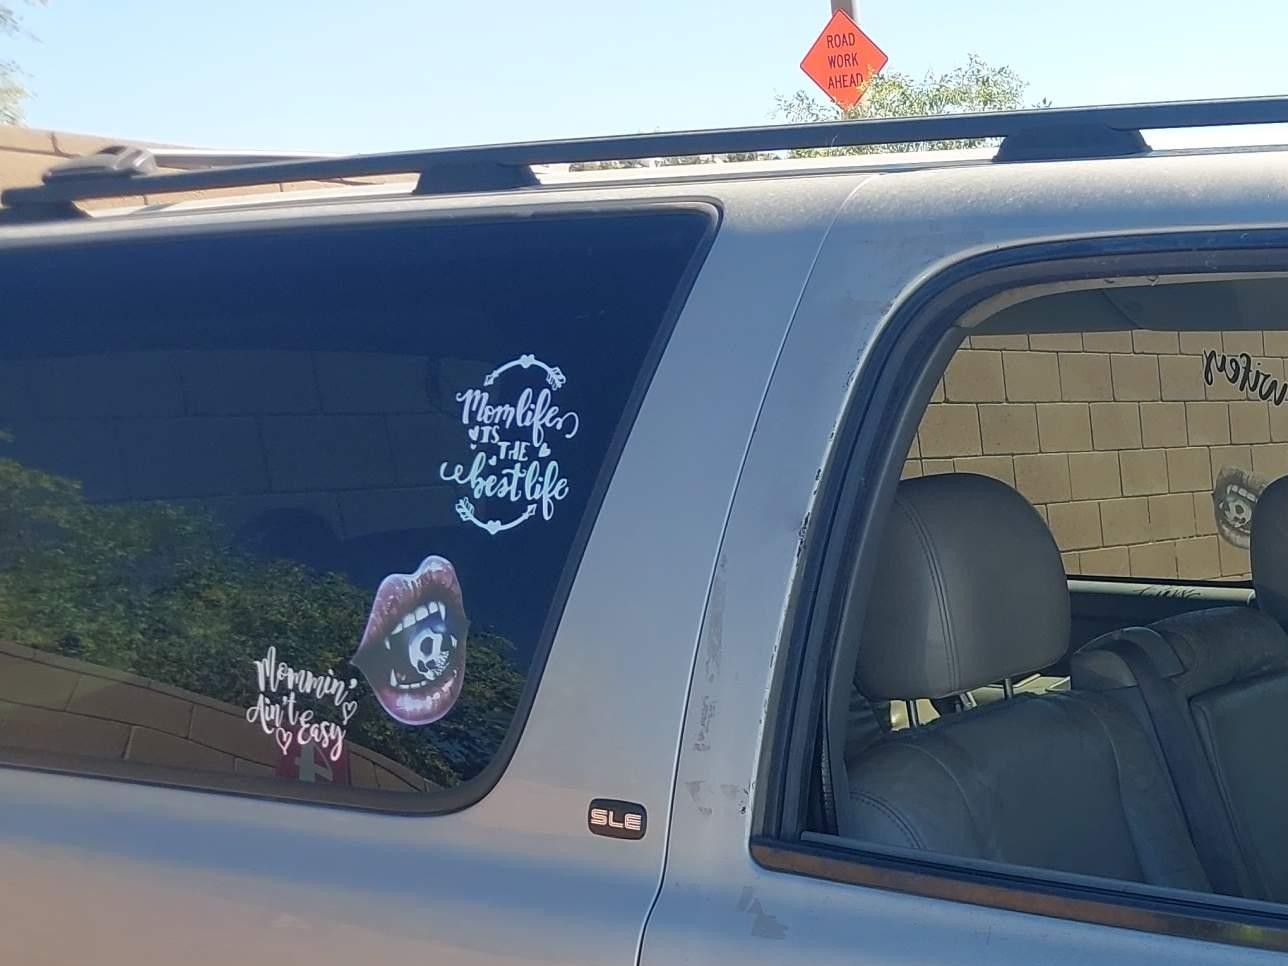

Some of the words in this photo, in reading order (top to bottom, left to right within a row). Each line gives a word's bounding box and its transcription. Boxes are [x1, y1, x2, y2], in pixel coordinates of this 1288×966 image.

[826, 32, 856, 49] ROAD
[827, 52, 859, 69] WORK
[828, 73, 864, 90] AHEAD
[480, 425, 501, 444] IS
[497, 440, 531, 461] THE
[253, 645, 359, 706] Mommin'
[246, 692, 299, 734] Ain't
[298, 710, 347, 761] Easy
[590, 808, 642, 831] SLE
